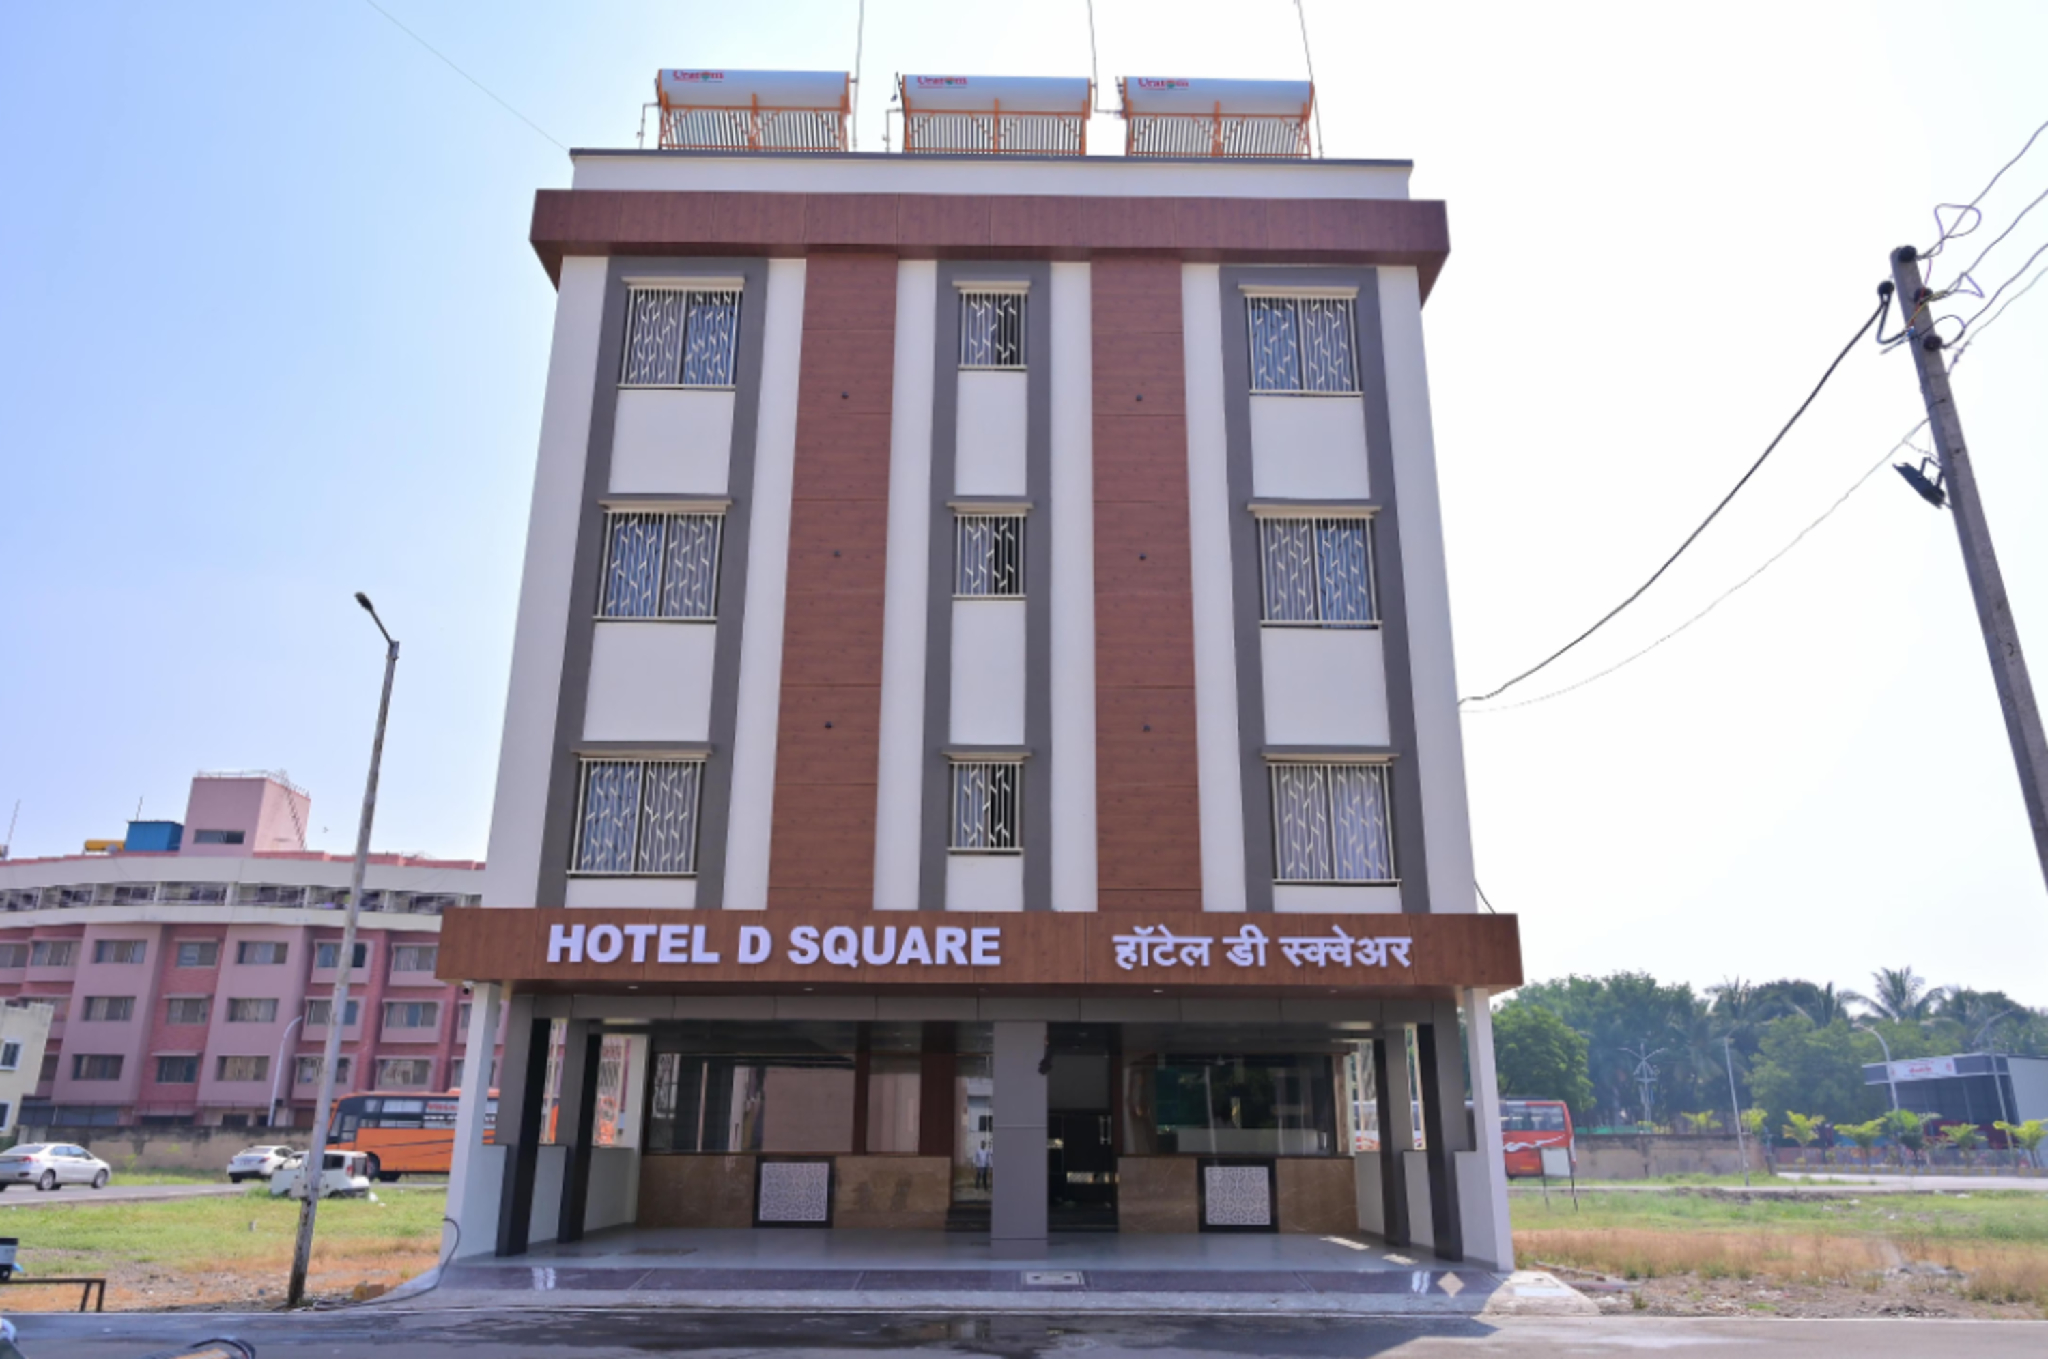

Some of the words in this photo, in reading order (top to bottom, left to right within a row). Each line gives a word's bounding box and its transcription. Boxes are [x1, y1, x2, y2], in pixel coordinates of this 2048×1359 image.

[547, 925, 720, 963] HOTEL
[739, 926, 772, 963] D
[788, 926, 1001, 967] SQUARE
[1112, 924, 1213, 969] हॉटेल
[1222, 924, 1269, 967] डी
[1279, 925, 1413, 967] स्क्वेअर
